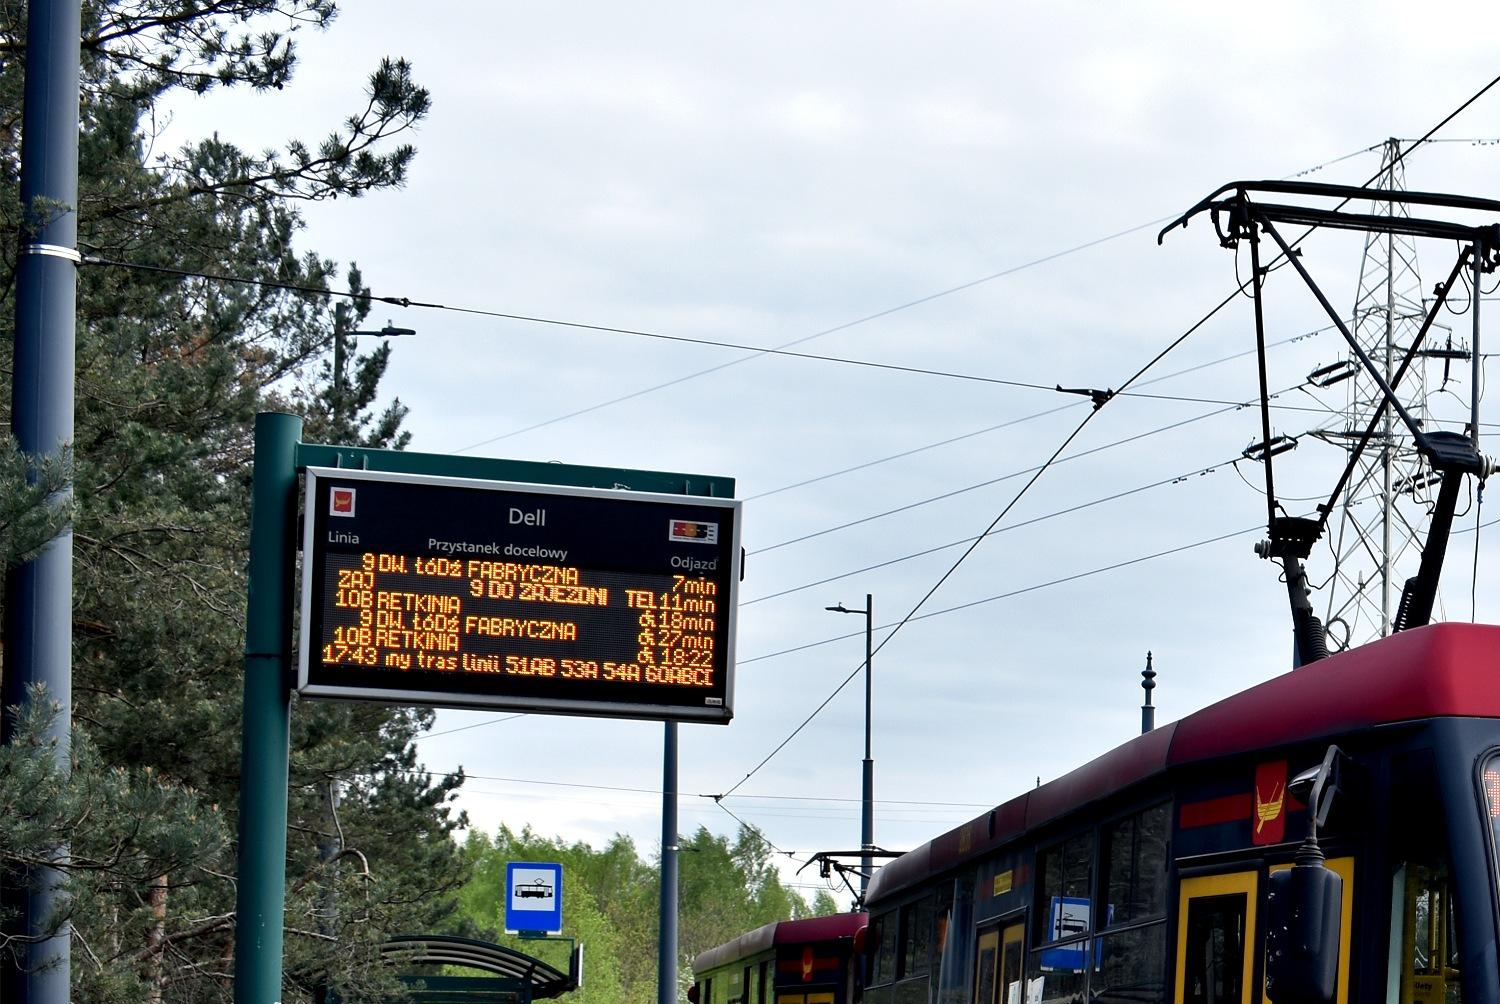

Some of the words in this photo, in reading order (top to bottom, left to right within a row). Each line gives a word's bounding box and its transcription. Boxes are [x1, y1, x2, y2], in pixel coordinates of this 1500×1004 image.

[508, 507, 547, 527] Dell
[327, 530, 361, 545] Linia
[428, 538, 500, 555] Przystanek
[503, 543, 569, 562] docelowy
[361, 552, 376, 572] 9
[467, 560, 579, 585] FABRYCZNA
[669, 555, 718, 572] Odjazd
[337, 569, 376, 590] ZAJ
[469, 579, 484, 598] 9
[487, 580, 516, 600] DO
[519, 583, 608, 606] ZAJEZDNI
[335, 588, 374, 609] 10B
[376, 591, 462, 615] RETKINIA
[658, 610, 716, 633] 18min
[333, 626, 372, 647] 10B
[374, 629, 460, 653] RETKINIA
[660, 647, 713, 668] 18:22
[359, 609, 373, 628] 9
[466, 616, 576, 640] FABRYCZNA
[657, 630, 715, 651] 27min
[322, 644, 378, 666] 17:43
[384, 652, 412, 670] ny
[416, 650, 459, 671] tras
[504, 655, 557, 677] 51AB
[560, 659, 600, 679] 53A
[602, 661, 642, 682] 54A
